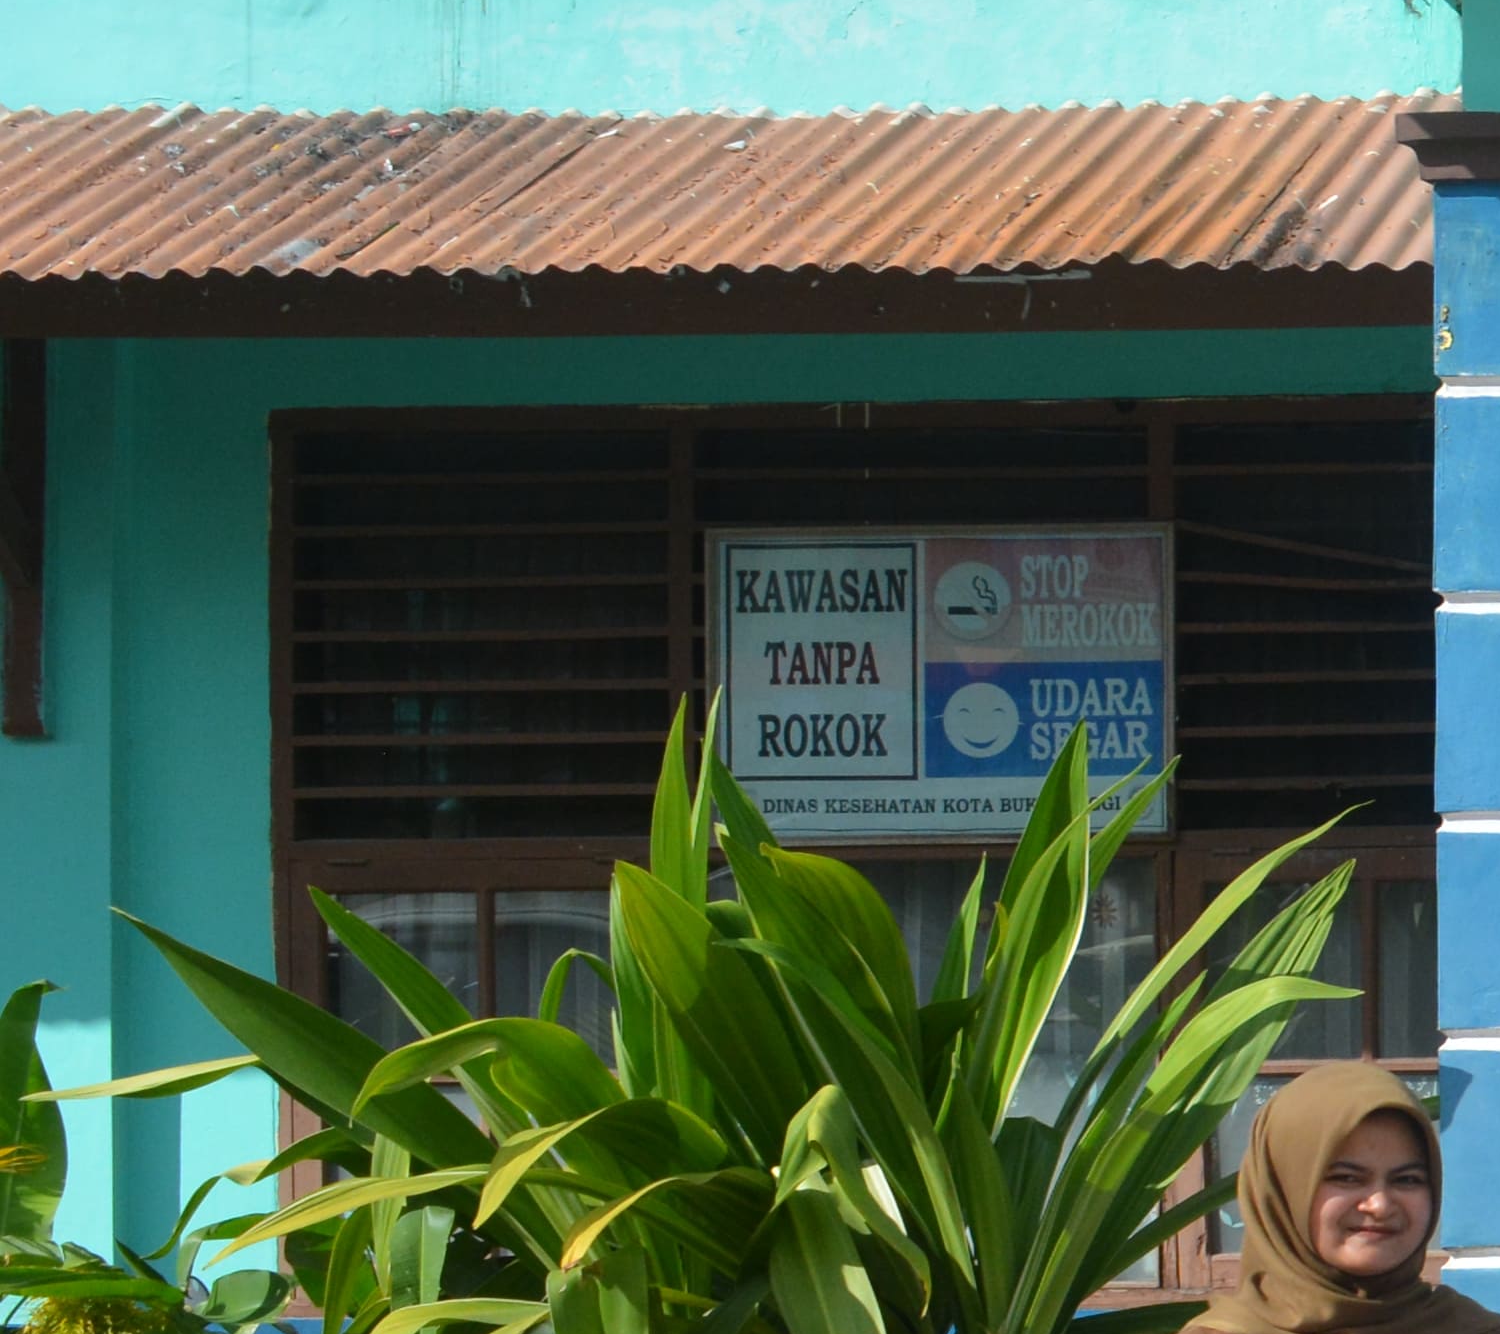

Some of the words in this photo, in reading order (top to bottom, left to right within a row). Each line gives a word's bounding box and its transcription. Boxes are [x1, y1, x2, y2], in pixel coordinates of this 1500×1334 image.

[736, 569, 908, 614] KAWASAN
[1020, 555, 1089, 600] STOP
[1020, 603, 1159, 648] MEROKOK
[764, 641, 880, 685] TANPA
[1030, 678, 1153, 718] UDARA
[758, 713, 888, 758] ROKOK
[763, 798, 819, 814] DINAS
[825, 798, 936, 815] KESEHATAN
[943, 797, 995, 814] KOTA
